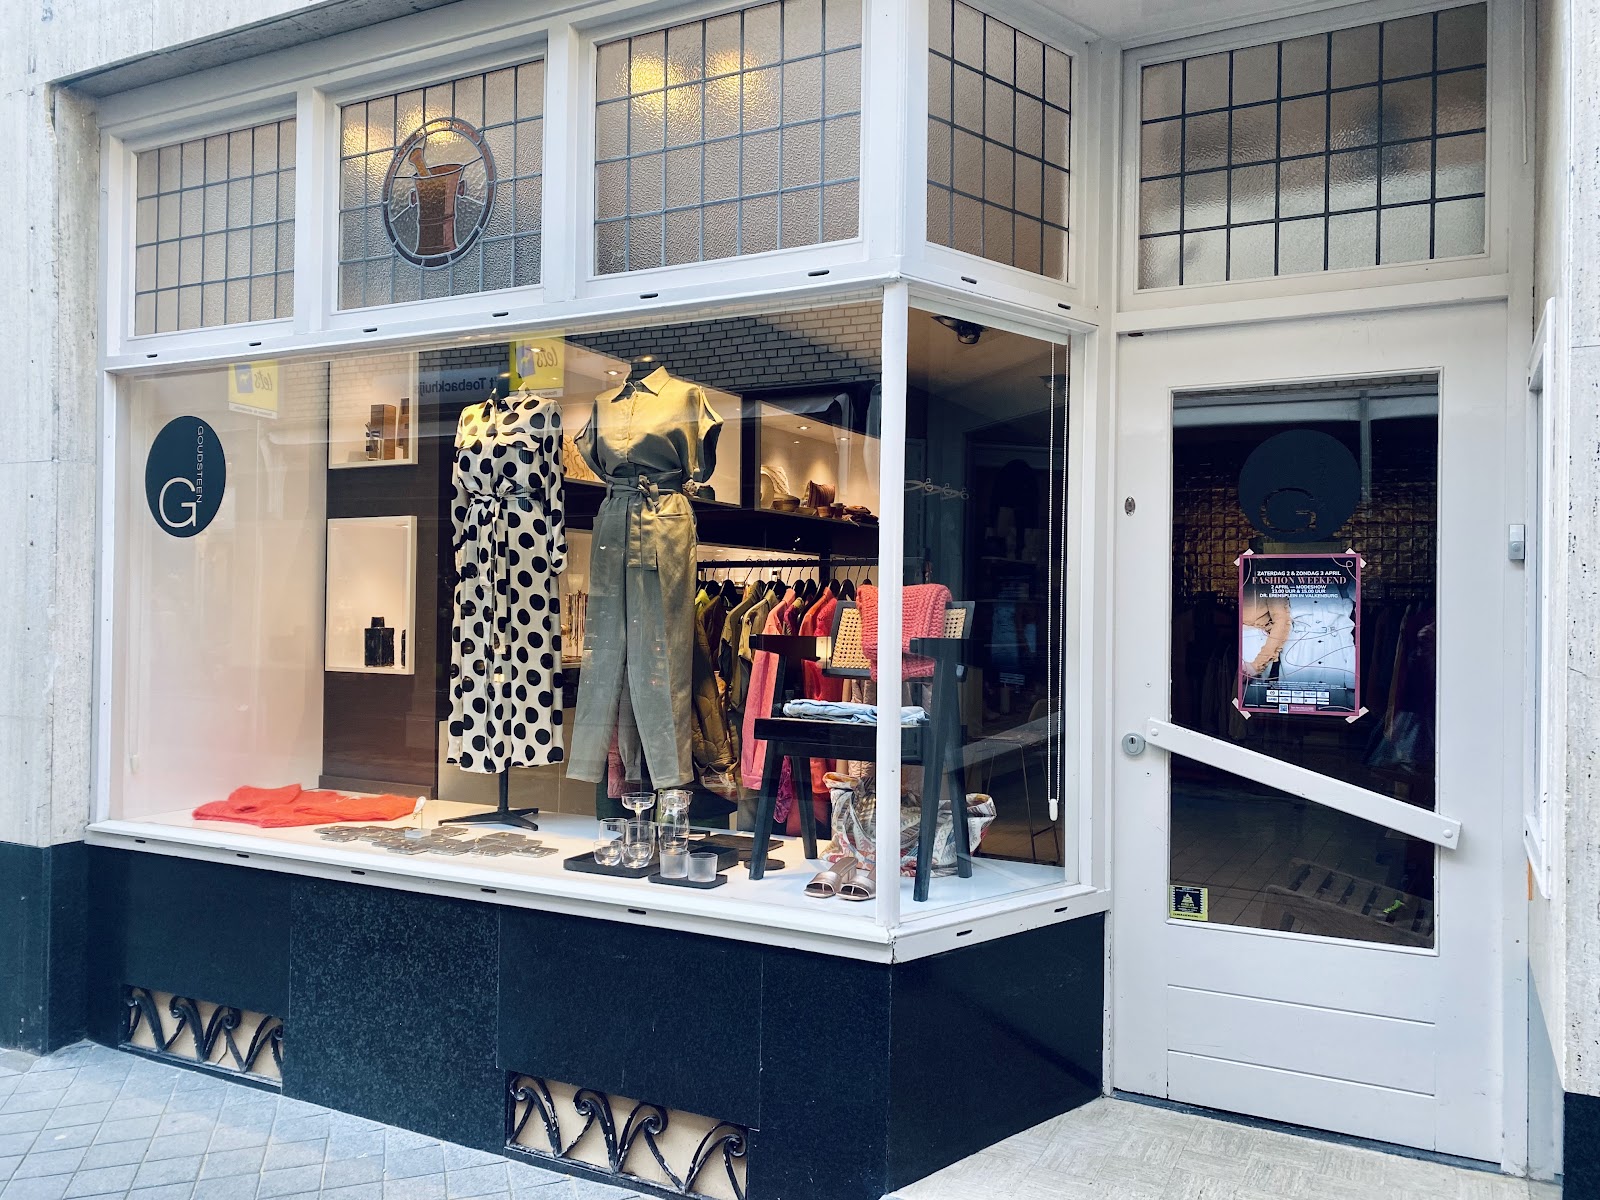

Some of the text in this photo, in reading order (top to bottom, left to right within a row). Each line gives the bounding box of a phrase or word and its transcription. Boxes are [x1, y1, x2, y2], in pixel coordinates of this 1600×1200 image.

[196, 426, 204, 503] GOUDSTEEN
[158, 477, 197, 528] G
[1258, 487, 1317, 533] G
[1252, 576, 1347, 585] FASHION WEEKEND
